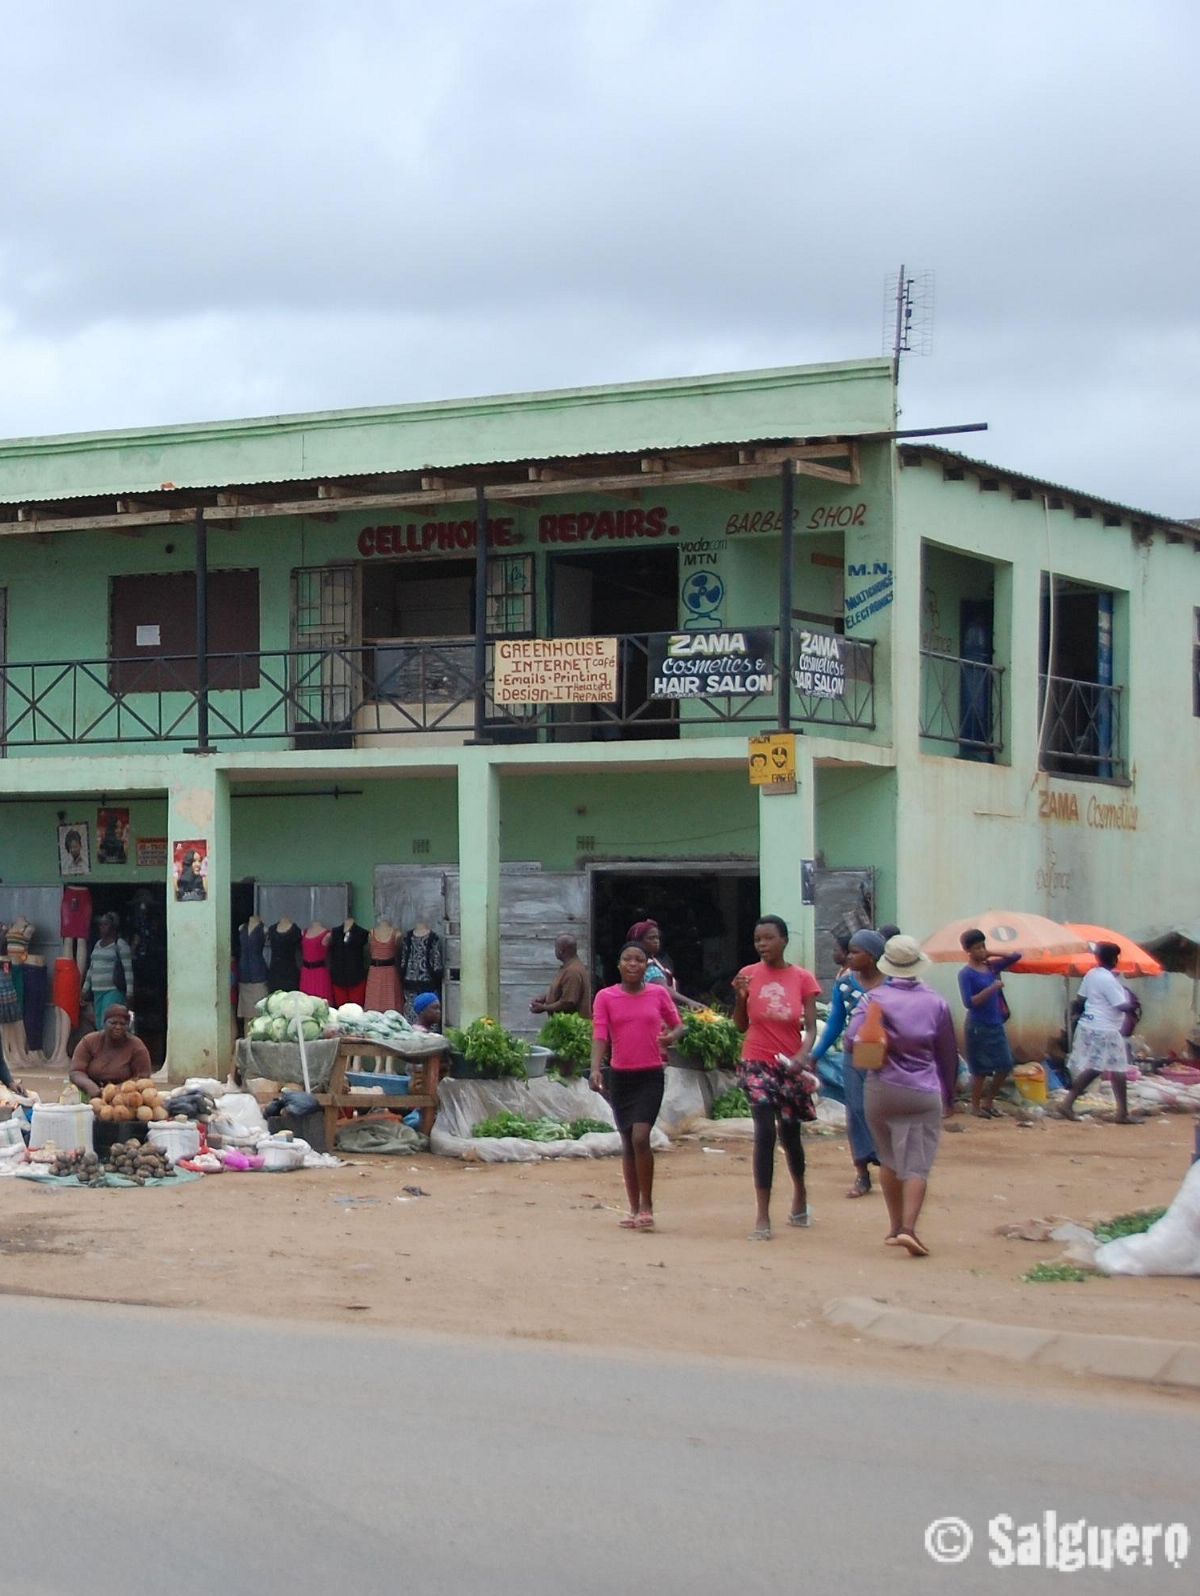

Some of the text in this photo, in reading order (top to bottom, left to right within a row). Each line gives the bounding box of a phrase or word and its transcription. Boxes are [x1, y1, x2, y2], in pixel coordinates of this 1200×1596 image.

[538, 506, 680, 544] REPAIRS.
[684, 553, 717, 566] MTN
[500, 641, 604, 658] GREENHOUSE
[668, 633, 746, 656] ZAMA
[799, 631, 840, 660] ZAMA
[512, 656, 615, 672] INTERNET café
[662, 656, 751, 674] Cosmetics
[799, 652, 840, 676] Cosmetics
[654, 673, 773, 694] HAIR SALON
[814, 673, 845, 695] SALON
[1039, 790, 1079, 822] ZAMA
